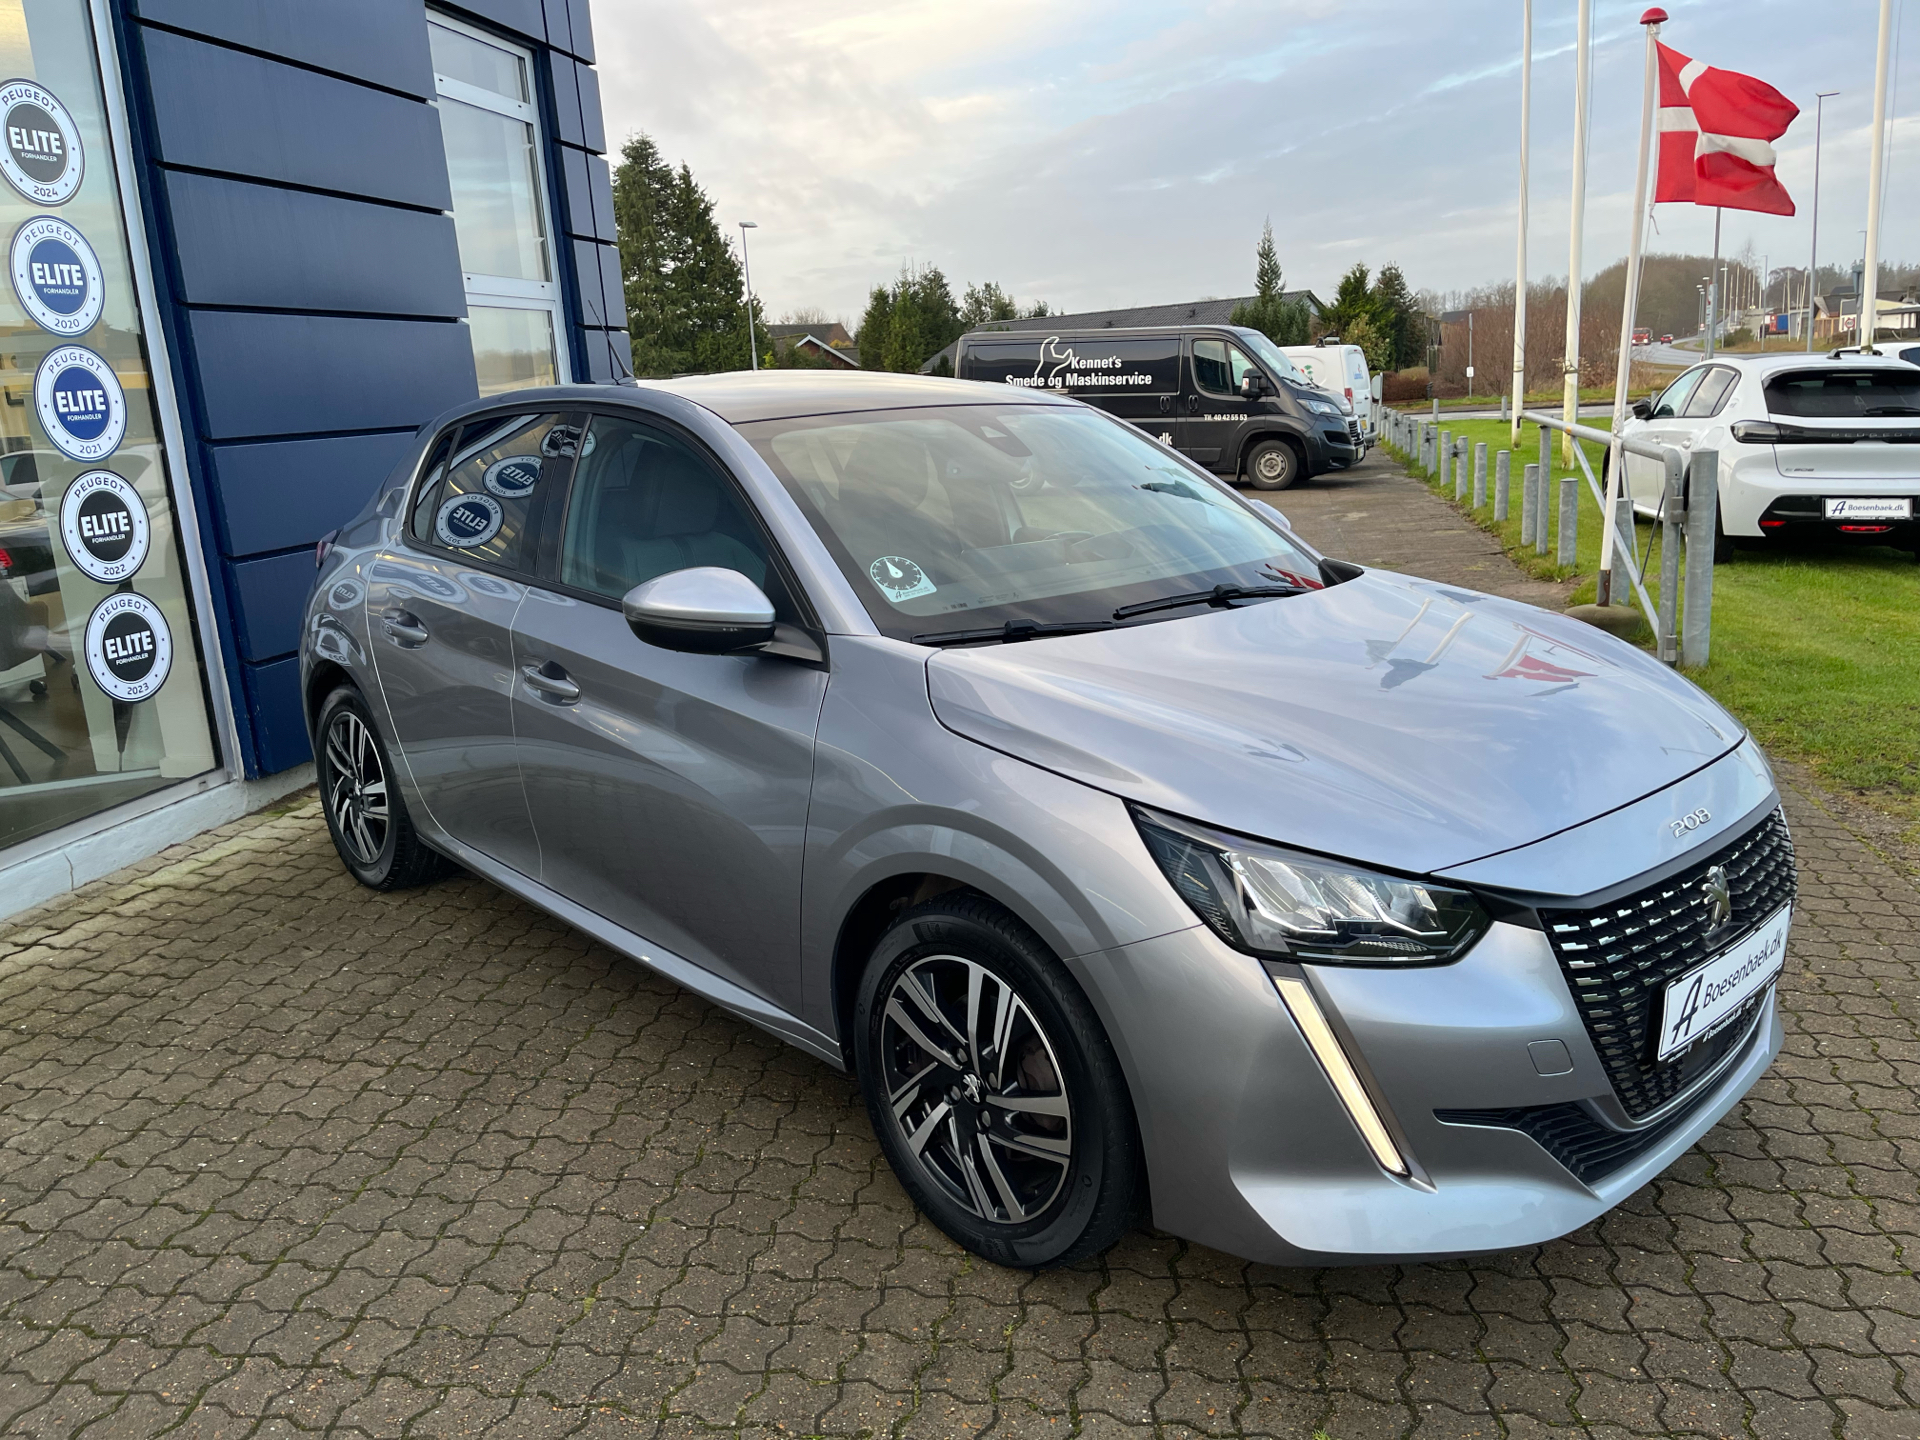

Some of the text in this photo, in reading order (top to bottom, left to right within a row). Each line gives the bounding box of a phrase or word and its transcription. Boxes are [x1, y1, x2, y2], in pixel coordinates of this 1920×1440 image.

[2, 88, 57, 113] PEUGEOT
[9, 126, 63, 155] ELITE
[21, 151, 58, 162] FORHANDLER
[33, 185, 58, 198] 2024
[24, 223, 80, 247] PEUGEOT
[31, 262, 84, 286] ELITE
[43, 287, 79, 295] FORHANDLER
[54, 317, 80, 329] 2020
[48, 351, 102, 374] PEUGEOT
[1071, 355, 1122, 370] Kennet's
[1005, 371, 1152, 389] Smede og Maskinservice
[55, 388, 107, 413] ELITE
[67, 413, 102, 422] FORHANDLER
[1213, 413, 1222, 421] 40
[1222, 413, 1231, 421] 42
[1230, 413, 1239, 421] 55
[1239, 413, 1248, 421] 53
[79, 443, 103, 455] 2021
[74, 477, 125, 499] PEUGEOT
[1848, 504, 1904, 512] Boesenbaek.dk
[80, 511, 130, 537] ELITE
[92, 534, 126, 544] FORHANDLER
[103, 564, 126, 576] 2022
[99, 599, 149, 622] PEUGEOT
[105, 630, 153, 660] ELITE
[116, 653, 149, 666] FORHANDLER
[127, 683, 150, 695] 2023
[1669, 807, 1711, 838] 208
[1671, 928, 1783, 1046] A Boesenbaek.dk
